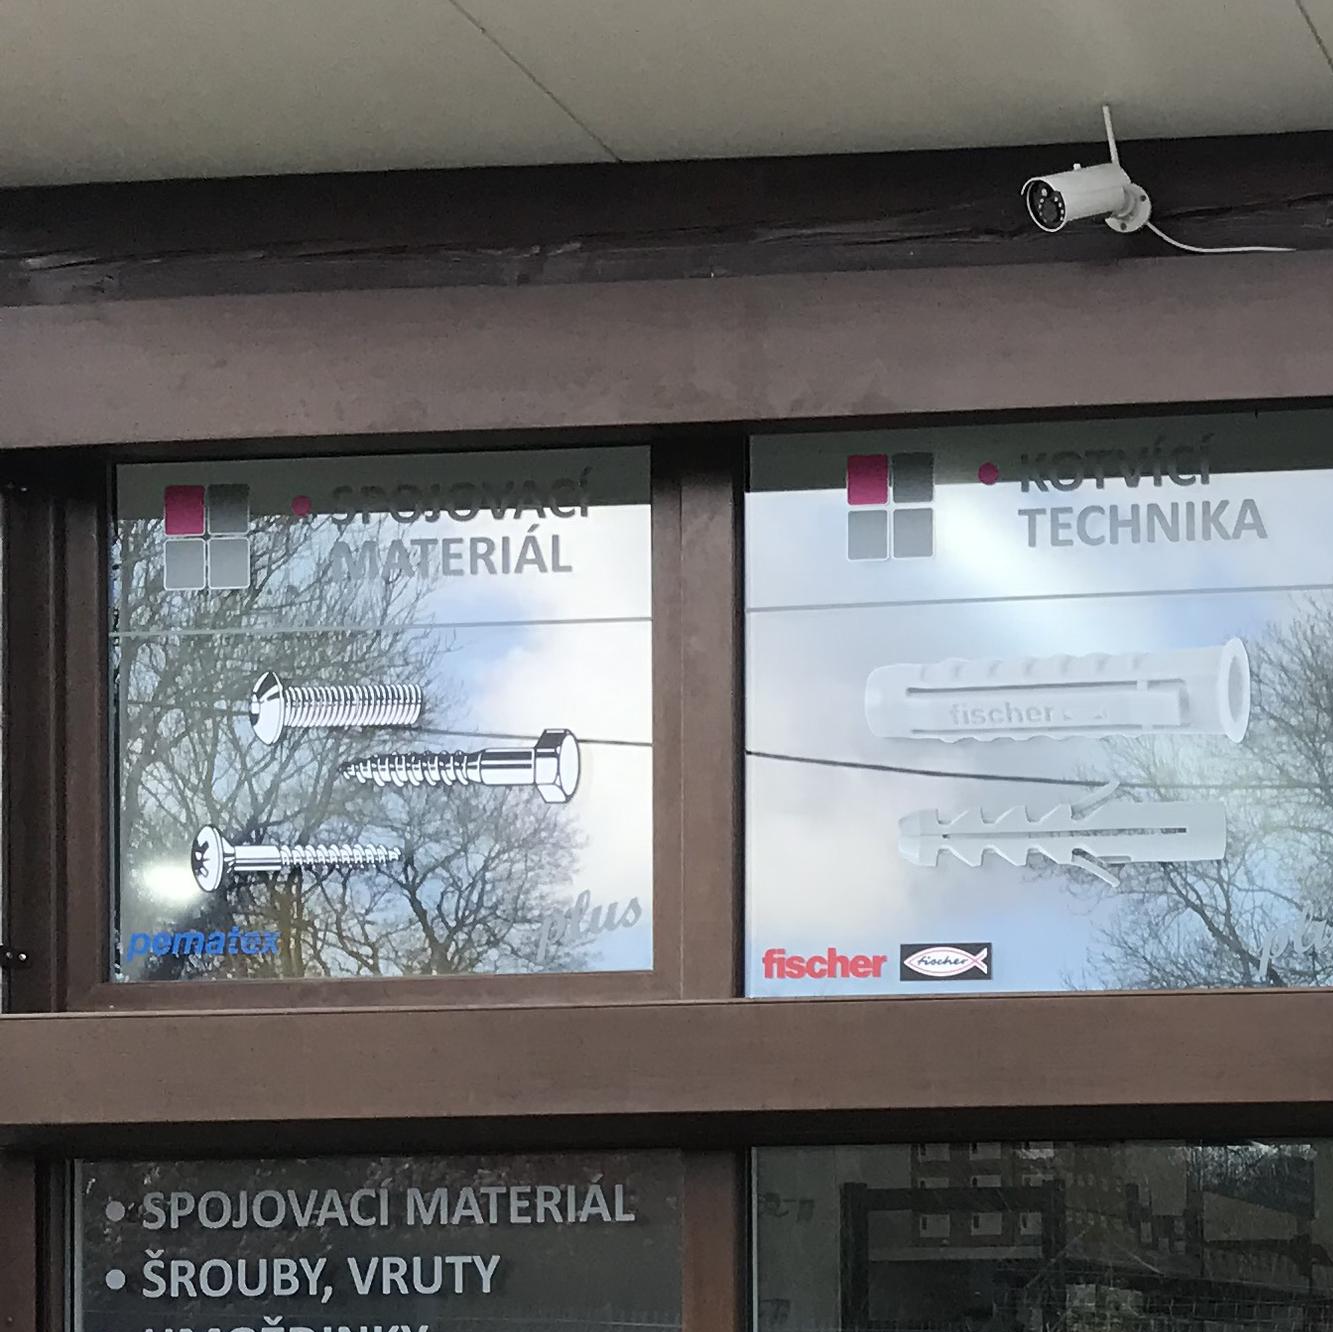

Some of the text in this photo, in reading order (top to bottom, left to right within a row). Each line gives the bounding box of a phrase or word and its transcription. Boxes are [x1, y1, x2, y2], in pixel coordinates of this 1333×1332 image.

[1018, 433, 1213, 493] KOTVÍCÍ
[331, 466, 592, 525] SPOJOVACÍ
[1017, 496, 1269, 549] TECHNIKA
[329, 523, 574, 581] MATERIÁL
[949, 702, 1055, 726] fischer
[535, 888, 644, 963] plus
[762, 947, 888, 979] fischer
[917, 955, 968, 967] fischer
[142, 1174, 636, 1230] SPOJOVACÍ MATERIÁL
[142, 1249, 501, 1304] ŠROUBY, VRUTY
